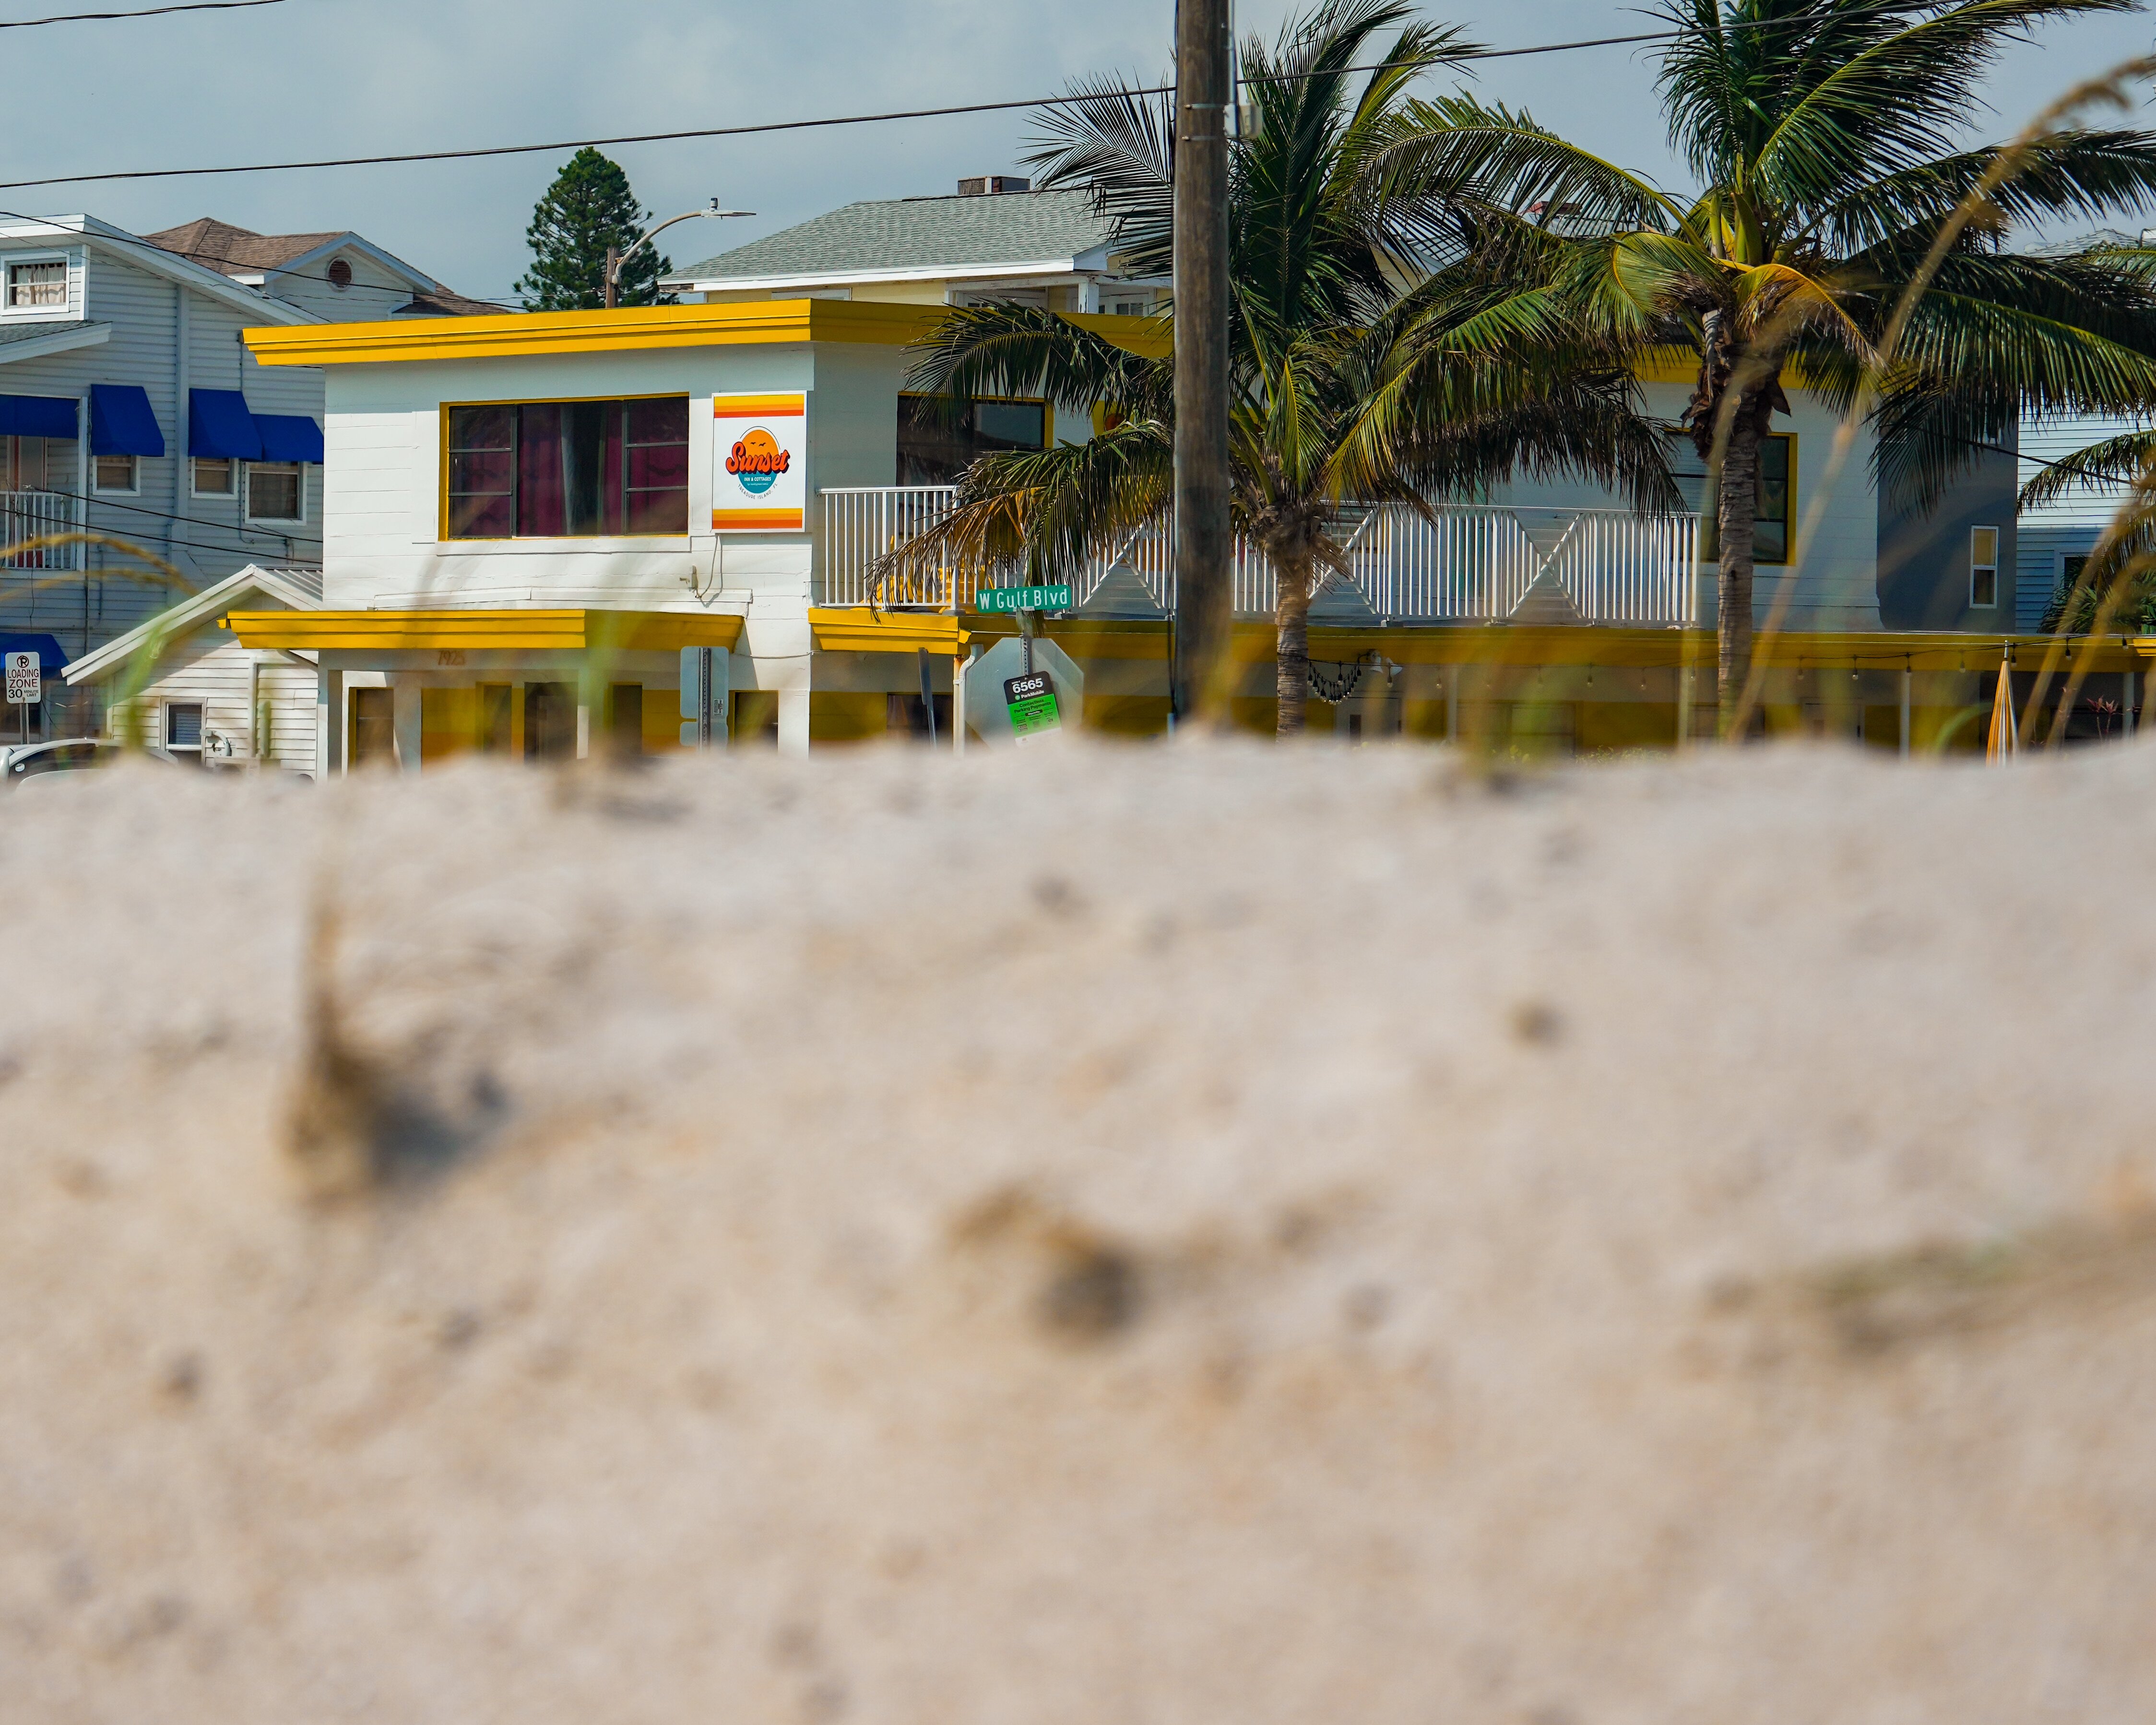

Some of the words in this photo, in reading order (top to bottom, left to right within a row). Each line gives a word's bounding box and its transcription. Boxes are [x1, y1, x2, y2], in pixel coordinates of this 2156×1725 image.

[725, 441, 790, 475] Sunset
[738, 484, 756, 500] TREASURE
[980, 593, 990, 610] W
[996, 590, 1027, 609] Gulf
[1034, 588, 1067, 607] Blvd
[7, 669, 39, 678] LOADING
[9, 678, 38, 688] ZONE
[1012, 678, 1043, 693] 6565
[8, 689, 23, 698] 30
[1021, 690, 1044, 699] ParkMobile
[1019, 699, 1044, 707] Contactless
[1014, 705, 1031, 714] Parking
